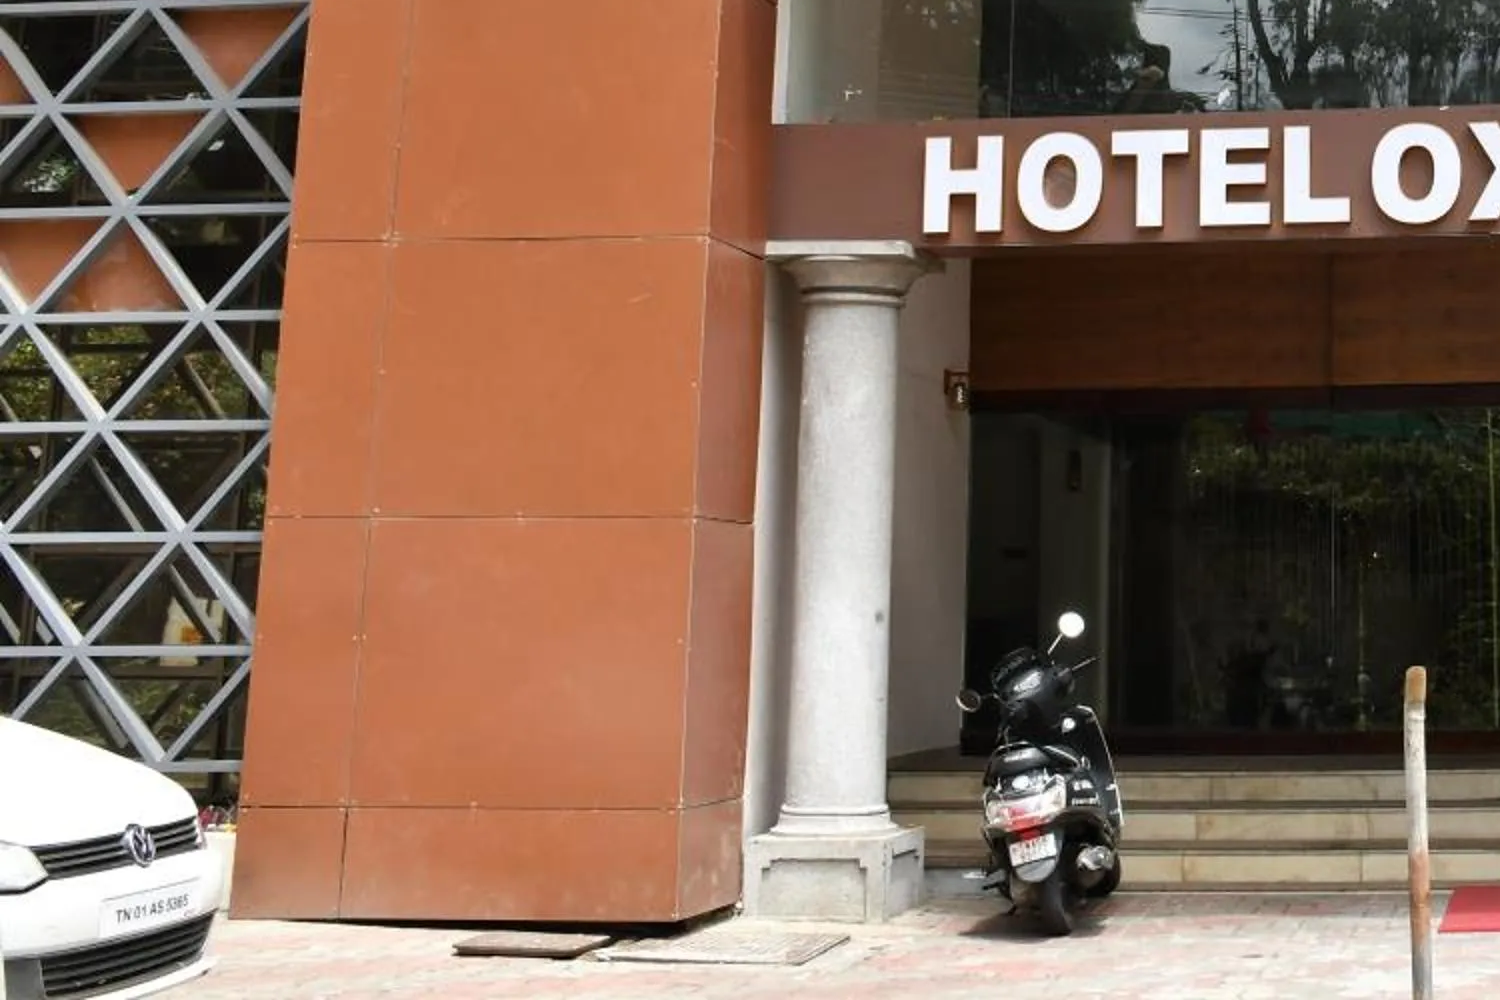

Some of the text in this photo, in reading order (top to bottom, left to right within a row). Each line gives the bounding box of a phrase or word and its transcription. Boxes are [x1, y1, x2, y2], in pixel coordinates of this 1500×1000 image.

[922, 125, 1351, 235] HOTEL
[116, 908, 131, 924] TN
[133, 904, 147, 919] 01
[150, 899, 165, 915] AS
